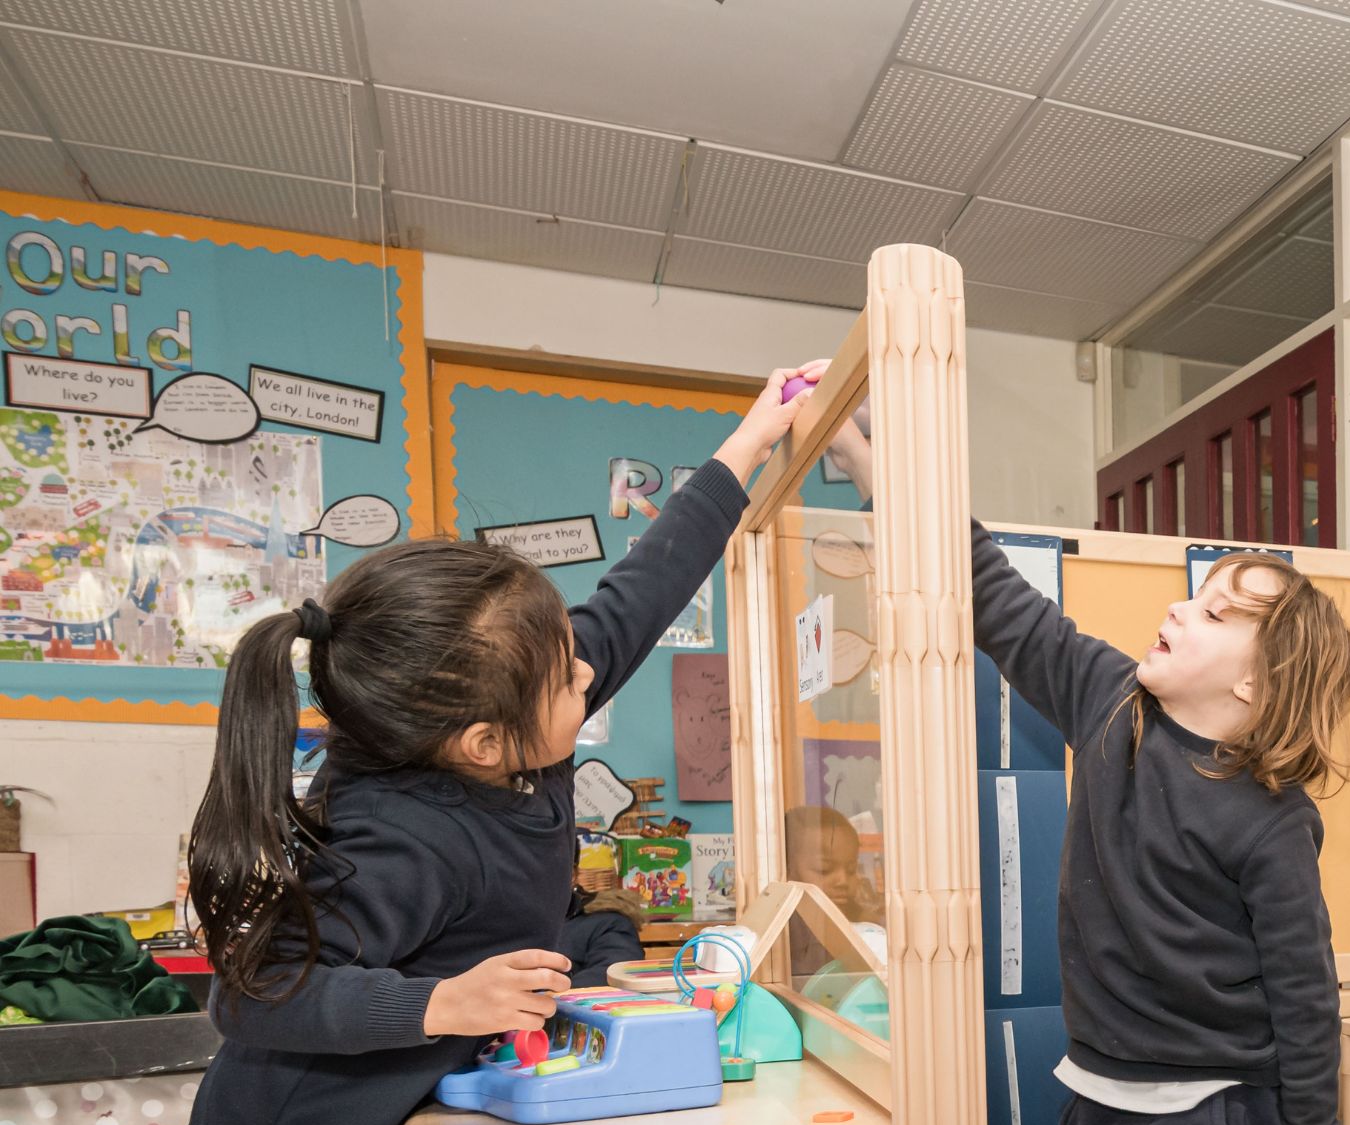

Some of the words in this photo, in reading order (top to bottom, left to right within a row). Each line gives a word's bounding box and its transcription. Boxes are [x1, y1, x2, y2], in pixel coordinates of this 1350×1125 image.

[7, 231, 170, 296] Our
[1, 303, 193, 372] orld
[24, 364, 79, 381] Where
[84, 371, 103, 384] do
[108, 377, 134, 388] you
[62, 388, 98, 403] live?
[258, 377, 281, 392] We
[286, 384, 302, 396] all
[307, 387, 330, 402] live
[336, 393, 347, 406] in
[352, 399, 376, 411] the
[307, 408, 359, 427] London!
[500, 535, 527, 546] Why
[531, 532, 552, 542] are
[555, 528, 581, 539] they
[546, 546, 559, 557] to
[563, 543, 589, 558] you?
[695, 845, 730, 860] Story
